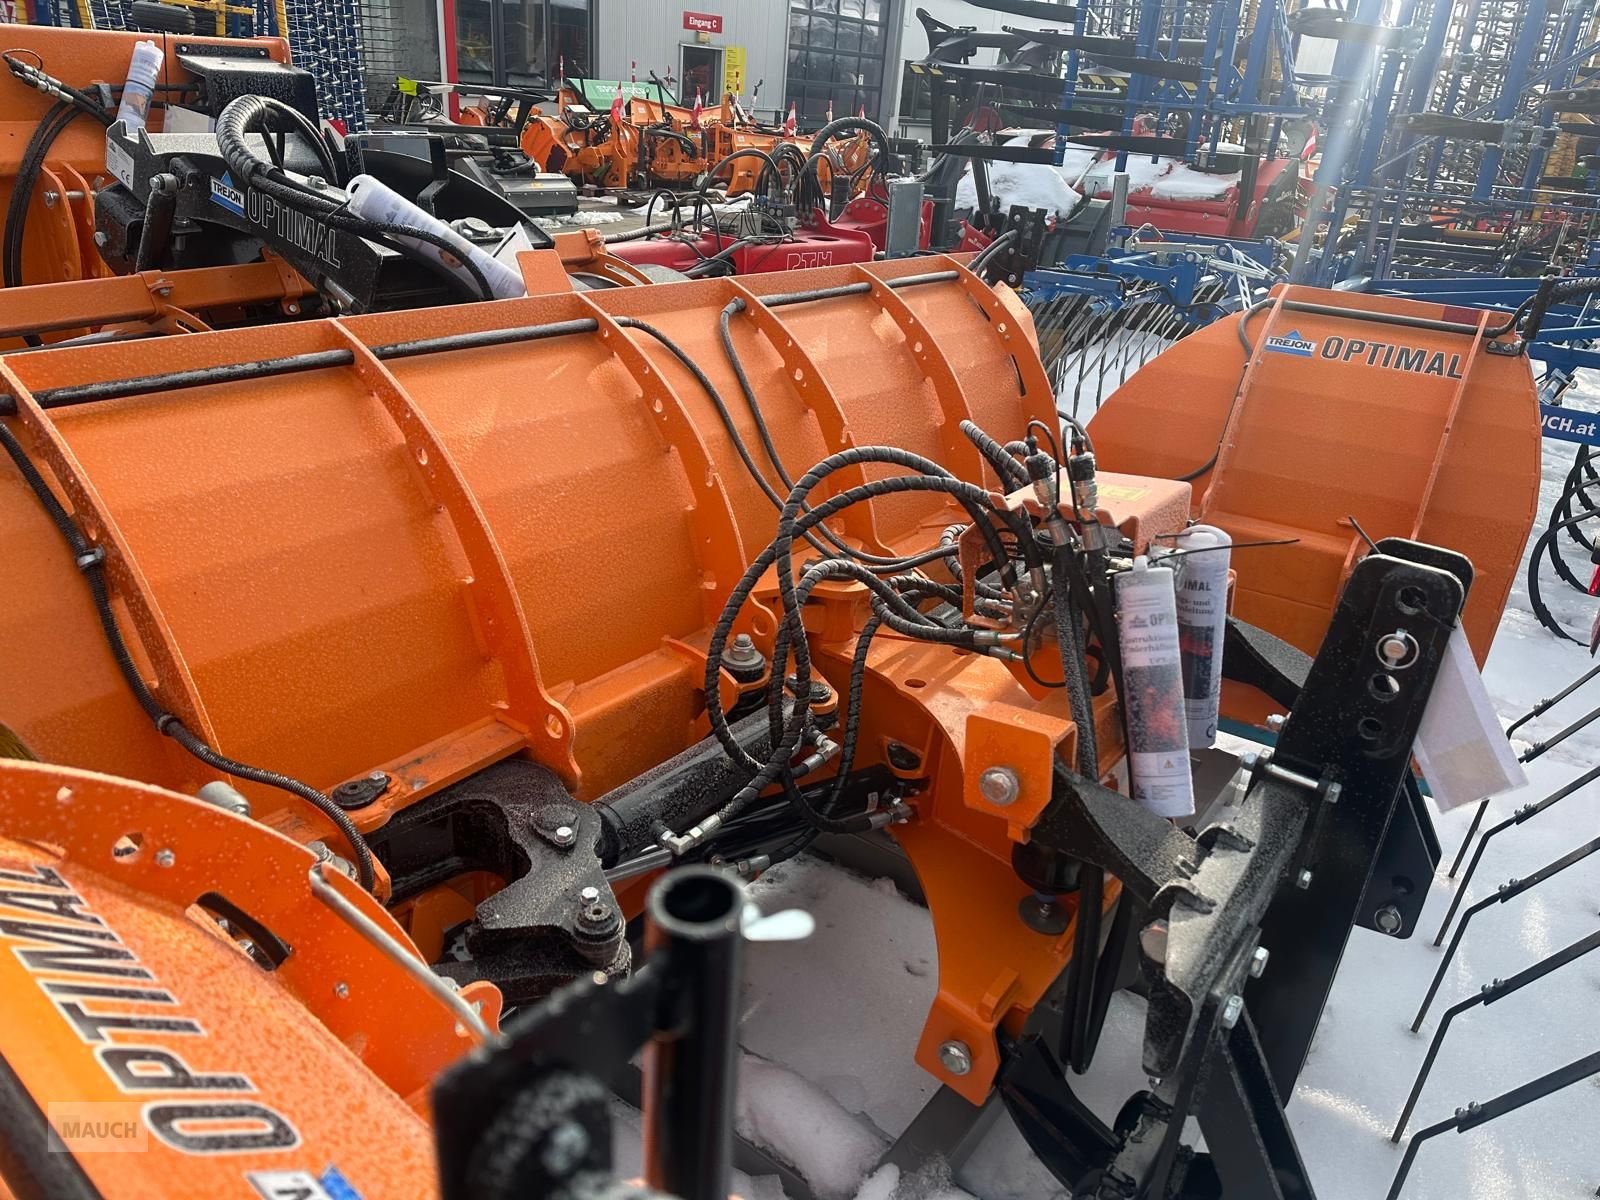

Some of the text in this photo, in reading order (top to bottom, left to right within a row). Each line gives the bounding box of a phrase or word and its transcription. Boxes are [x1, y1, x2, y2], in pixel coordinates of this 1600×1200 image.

[689, 16, 717, 29] Eingang C
[212, 181, 243, 206] TREJON
[247, 185, 341, 269] OPTIMAL
[1268, 337, 1313, 351] TREJON
[1320, 335, 1464, 380] OPTIMAL
[1541, 414, 1597, 437] UCH.at
[1184, 580, 1212, 591] IMAL
[0, 864, 304, 1156] OPTIMAL
